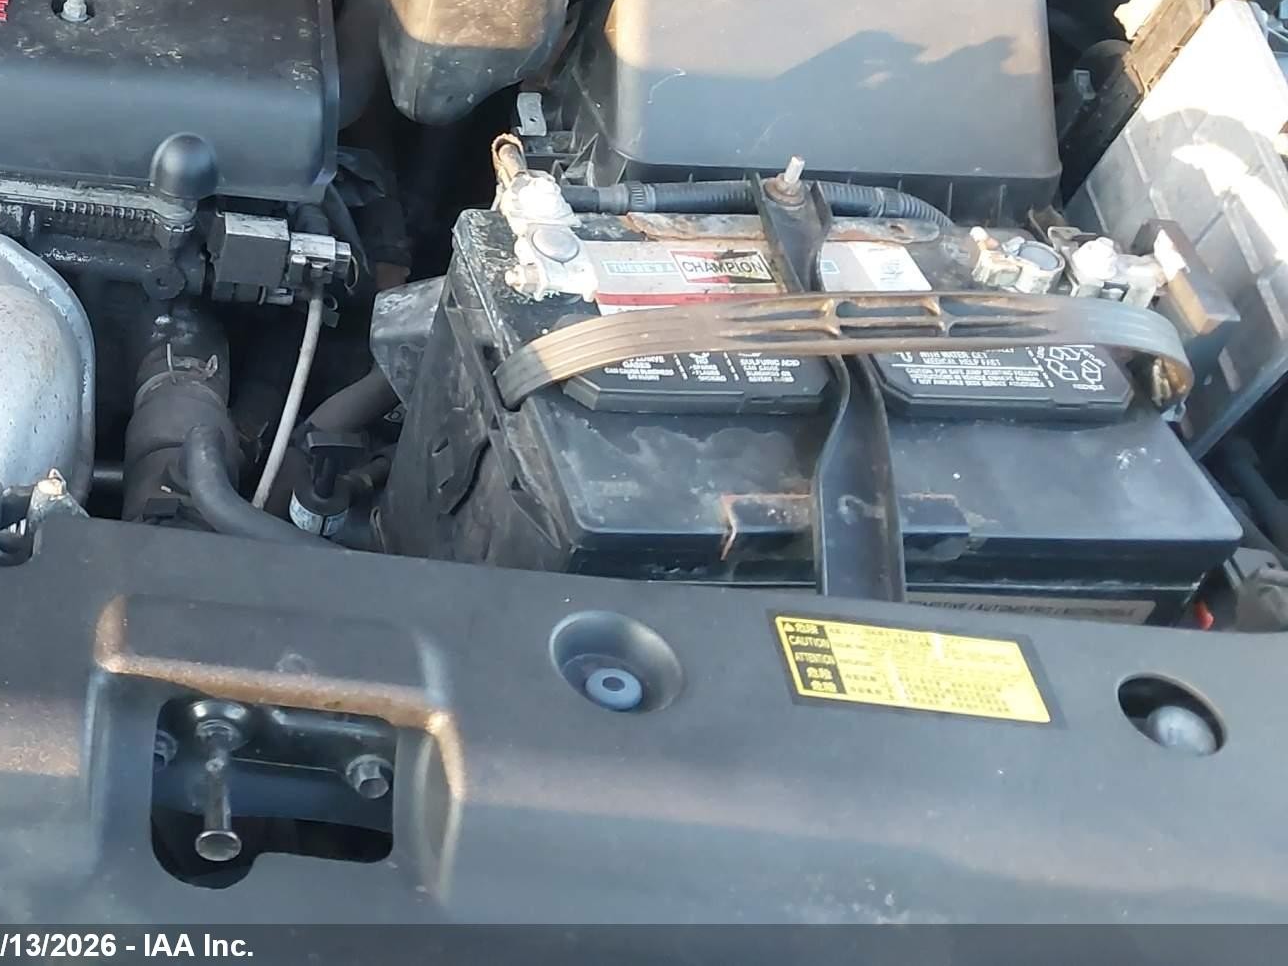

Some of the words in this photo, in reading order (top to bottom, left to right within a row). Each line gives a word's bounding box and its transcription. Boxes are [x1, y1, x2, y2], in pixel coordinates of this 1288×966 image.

[682, 260, 765, 274] CHAMPION
[781, 359, 801, 367] ACID
[789, 634, 830, 649] CAUTION
